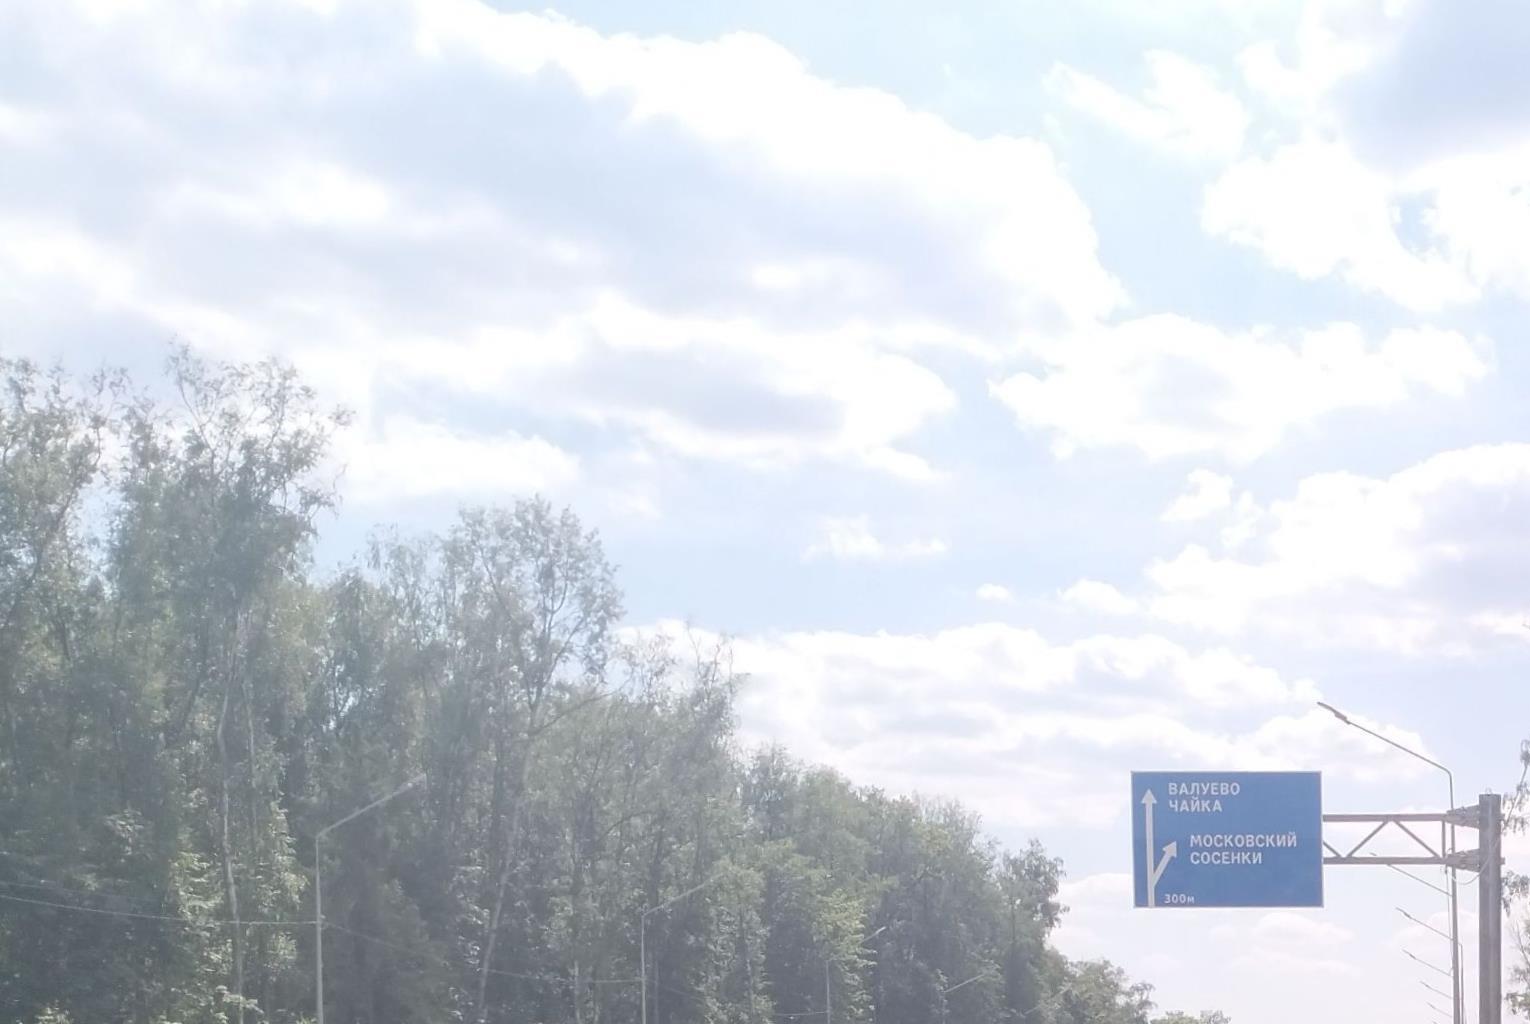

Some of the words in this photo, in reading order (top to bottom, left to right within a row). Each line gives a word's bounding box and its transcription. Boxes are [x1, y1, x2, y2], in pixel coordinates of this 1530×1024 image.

[1168, 782, 1240, 796] ВАЛУЕВО
[1169, 796, 1223, 812] ЧАЙКА
[1190, 831, 1297, 848] МОСКОВСКИЙ
[1190, 851, 1263, 865] СОСЕНКИ
